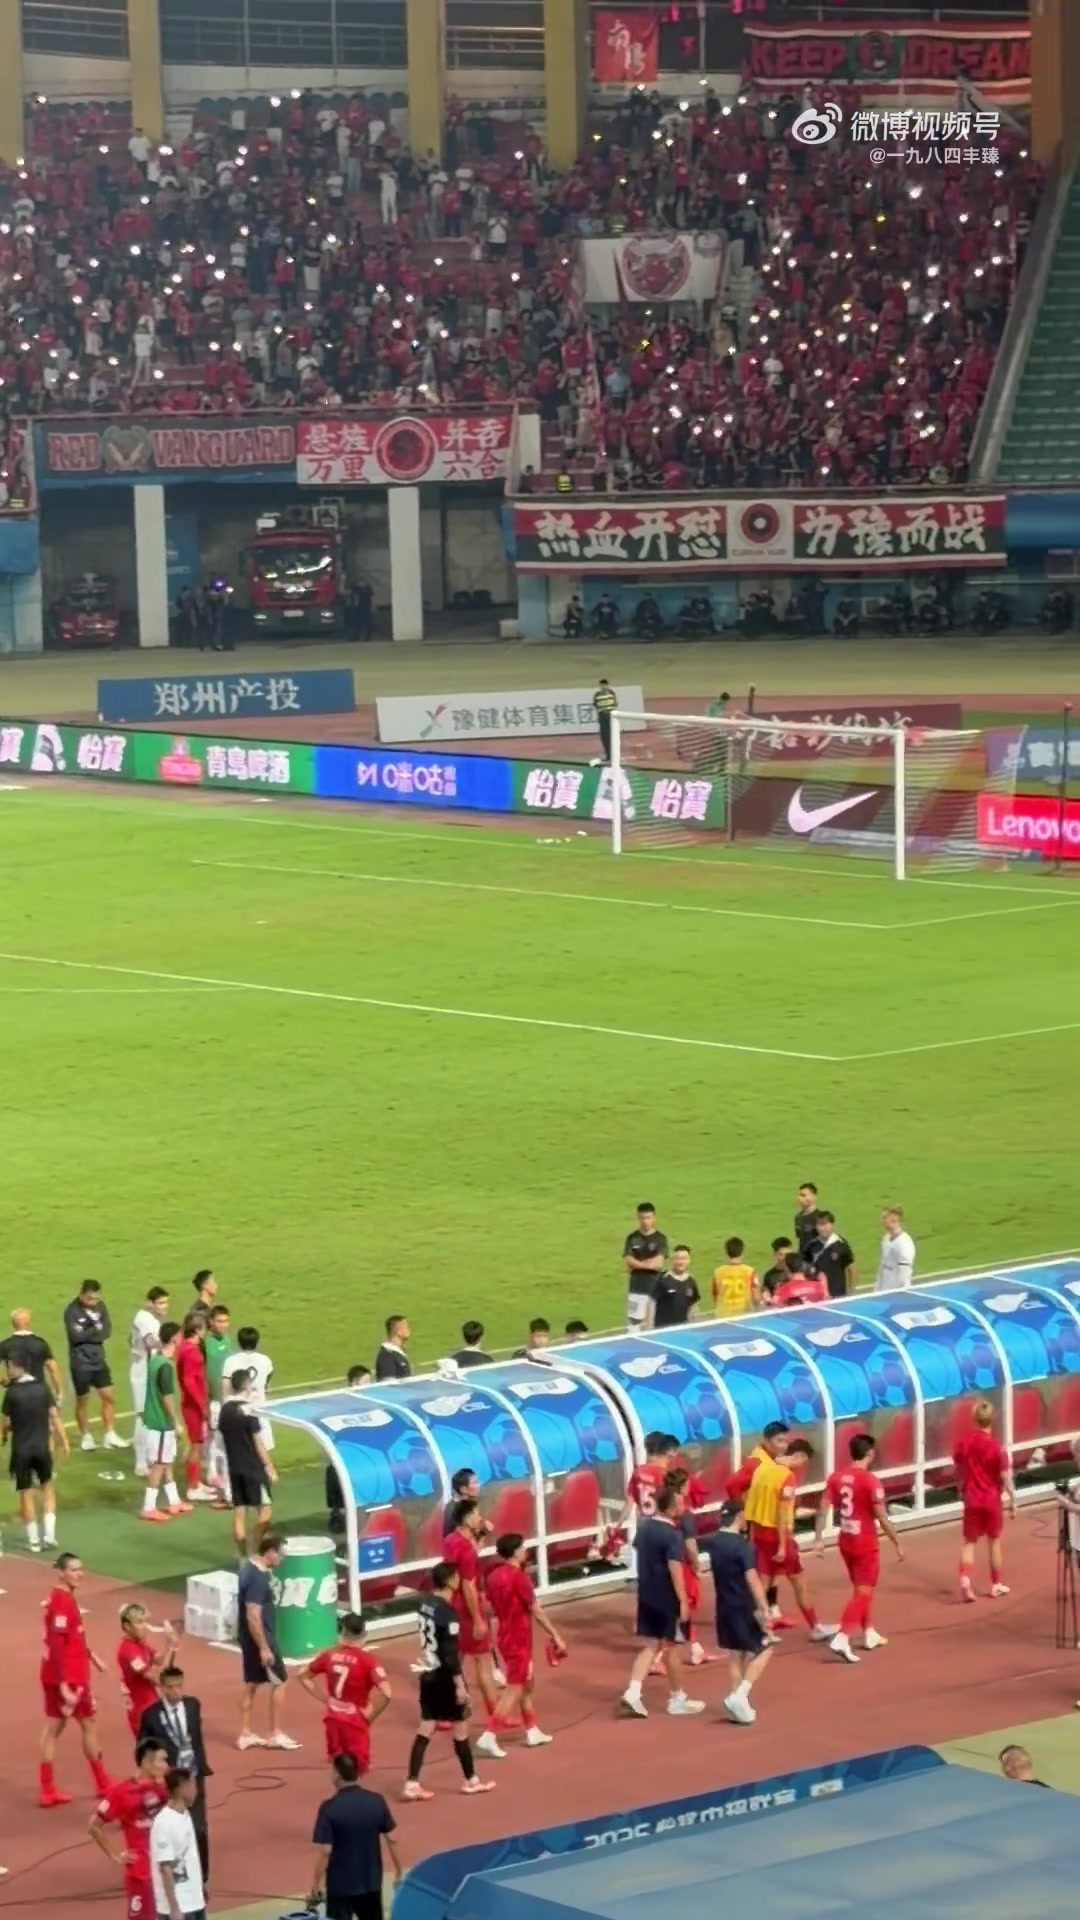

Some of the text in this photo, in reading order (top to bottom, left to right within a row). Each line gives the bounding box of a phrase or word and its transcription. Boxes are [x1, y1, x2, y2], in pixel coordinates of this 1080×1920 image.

[752, 39, 847, 76] KEEP
[48, 426, 295, 471] RED VANGUARD
[154, 678, 301, 716] 郑州产投
[451, 703, 601, 732] 豫健体育集团
[988, 808, 1080, 844] Lenovo
[840, 1486, 854, 1517] 3
[332, 1664, 350, 1700] 7
[131, 1895, 143, 1911] 6
